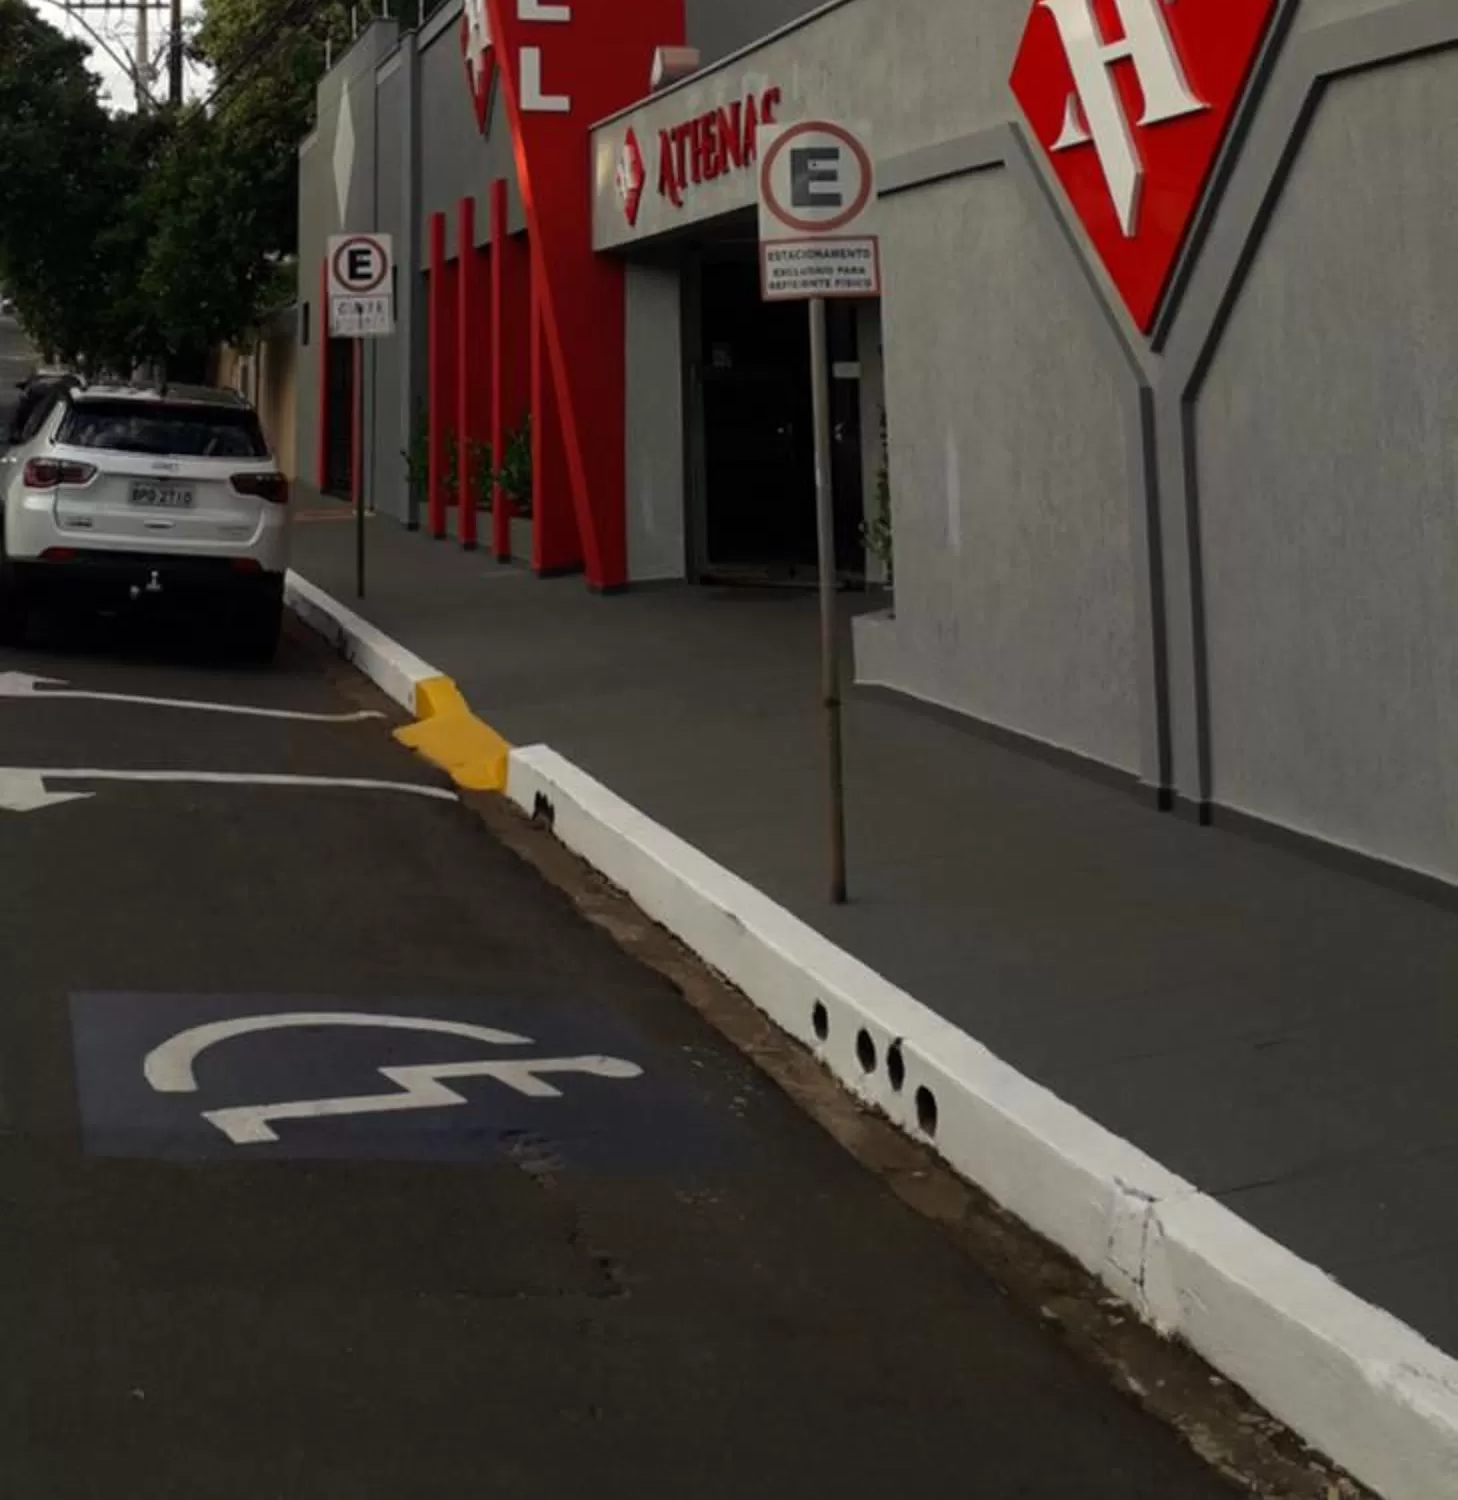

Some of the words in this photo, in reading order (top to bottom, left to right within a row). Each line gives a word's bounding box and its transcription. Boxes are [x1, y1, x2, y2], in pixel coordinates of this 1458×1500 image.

[789, 146, 843, 208] E
[348, 249, 373, 280] E
[767, 247, 871, 261] ESTACIONAMENTO
[836, 265, 866, 275] PARA
